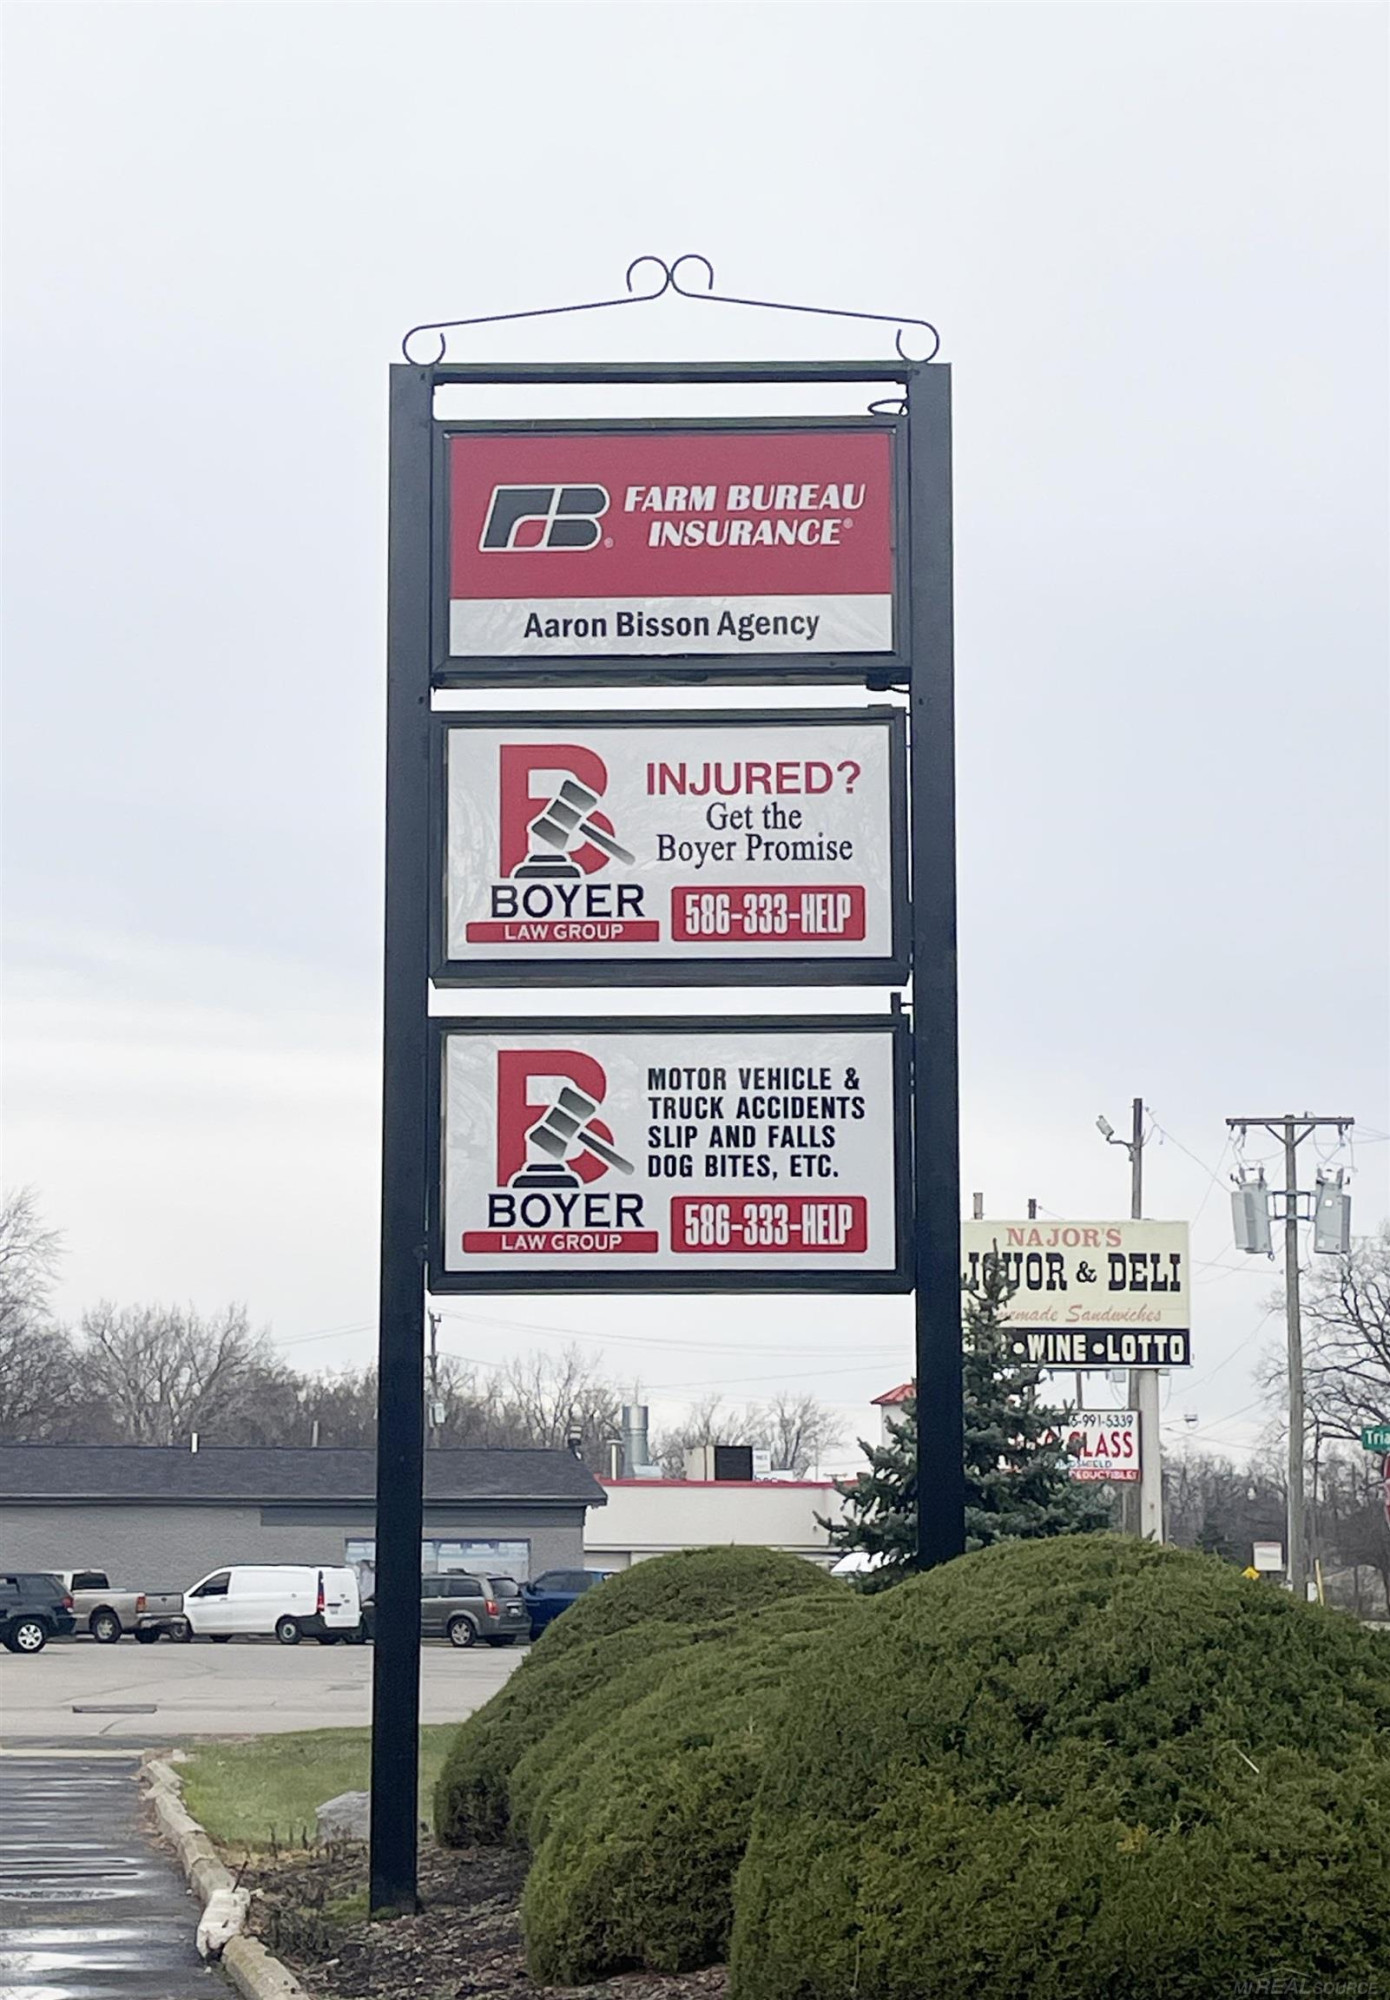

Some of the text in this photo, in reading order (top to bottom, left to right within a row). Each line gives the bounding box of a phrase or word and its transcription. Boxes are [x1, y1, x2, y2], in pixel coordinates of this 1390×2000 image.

[625, 484, 865, 511] FARM BUREAU
[524, 611, 819, 641] Aaron Bisson Agency
[647, 761, 860, 795] INJURED?
[707, 802, 801, 830] Get the
[657, 832, 852, 869] Boyer Promise
[492, 884, 644, 918] BOYER
[686, 894, 850, 934] 586-333-HELP
[505, 924, 623, 940] LAW GROUP
[648, 1068, 859, 1090] MOTOR VEHICLE &
[648, 1096, 864, 1119] TRUCK ACCIDENTS
[649, 1125, 835, 1148] SLIP AND FALLS
[649, 1155, 838, 1179] DOG BITES, ETC.
[488, 1193, 644, 1228] BOYER
[686, 1204, 852, 1245] 586-333-HELP
[502, 1233, 621, 1252] LAW GROUP
[1007, 1228, 1121, 1247] NAJOR'S
[1075, 1261, 1097, 1284] &
[1108, 1253, 1180, 1292] DELI
[1065, 1303, 1162, 1324] Sandwiches
[1027, 1334, 1087, 1363] WINE
[1107, 1335, 1184, 1362] LOTTO
